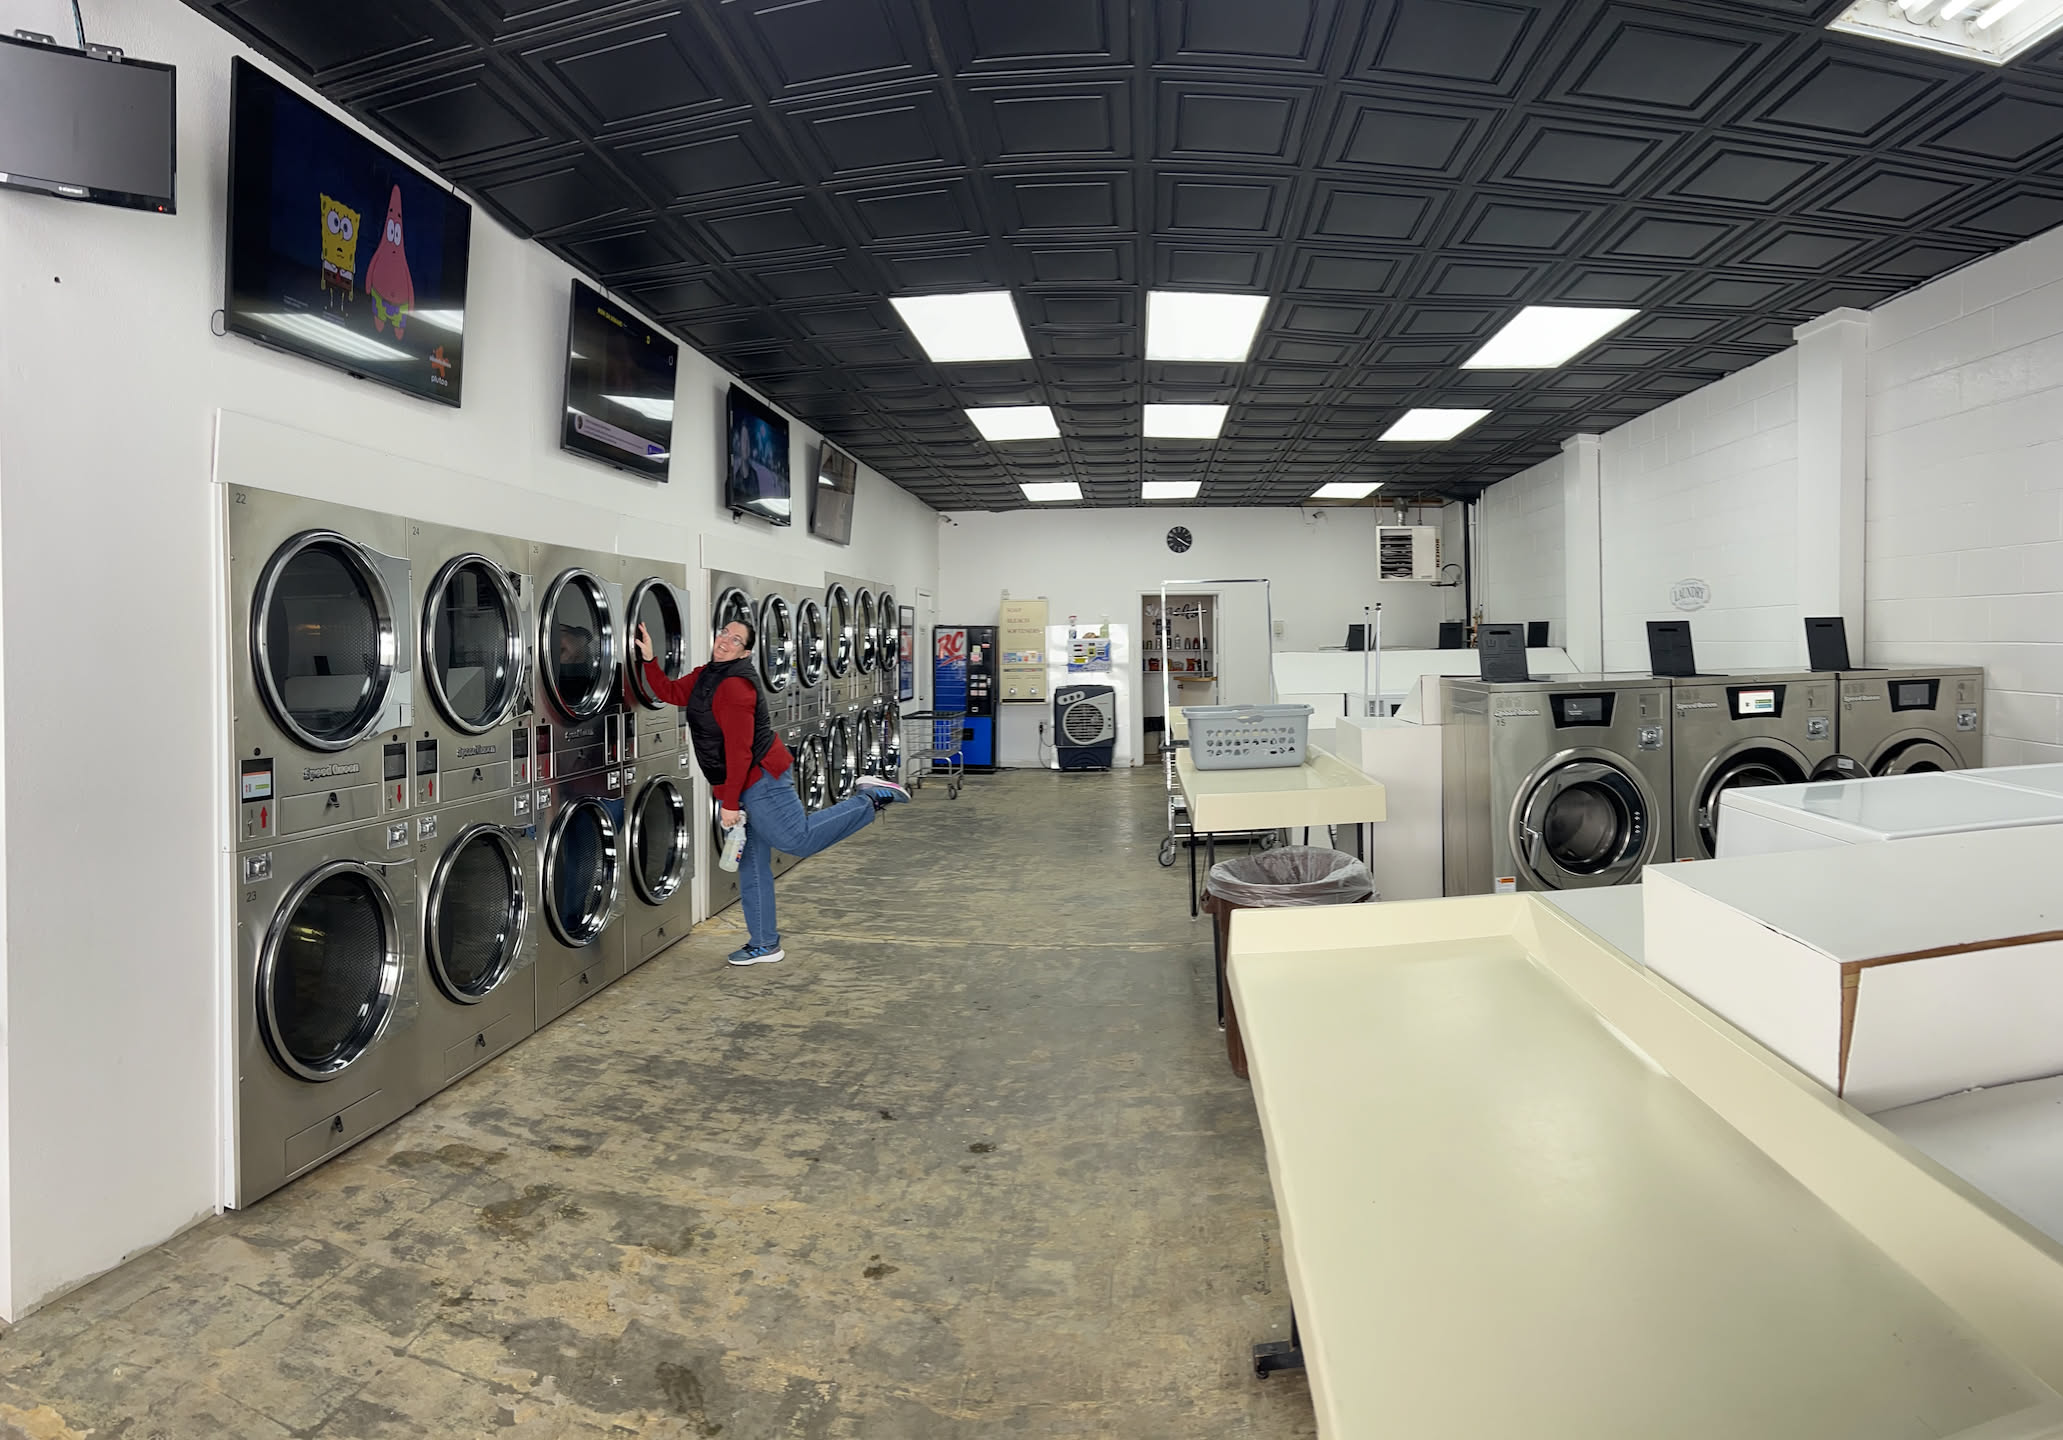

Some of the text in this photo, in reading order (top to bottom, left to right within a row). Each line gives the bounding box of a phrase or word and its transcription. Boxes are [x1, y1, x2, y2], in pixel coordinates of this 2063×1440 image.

[235, 492, 247, 505] 22
[412, 525, 420, 536] 24
[1673, 586, 1704, 602] LAUNDRY
[937, 631, 965, 660] RC
[1496, 719, 1506, 727] 15
[303, 763, 360, 782] Speed Queen
[419, 843, 427, 853] 25
[245, 891, 257, 902] 23
